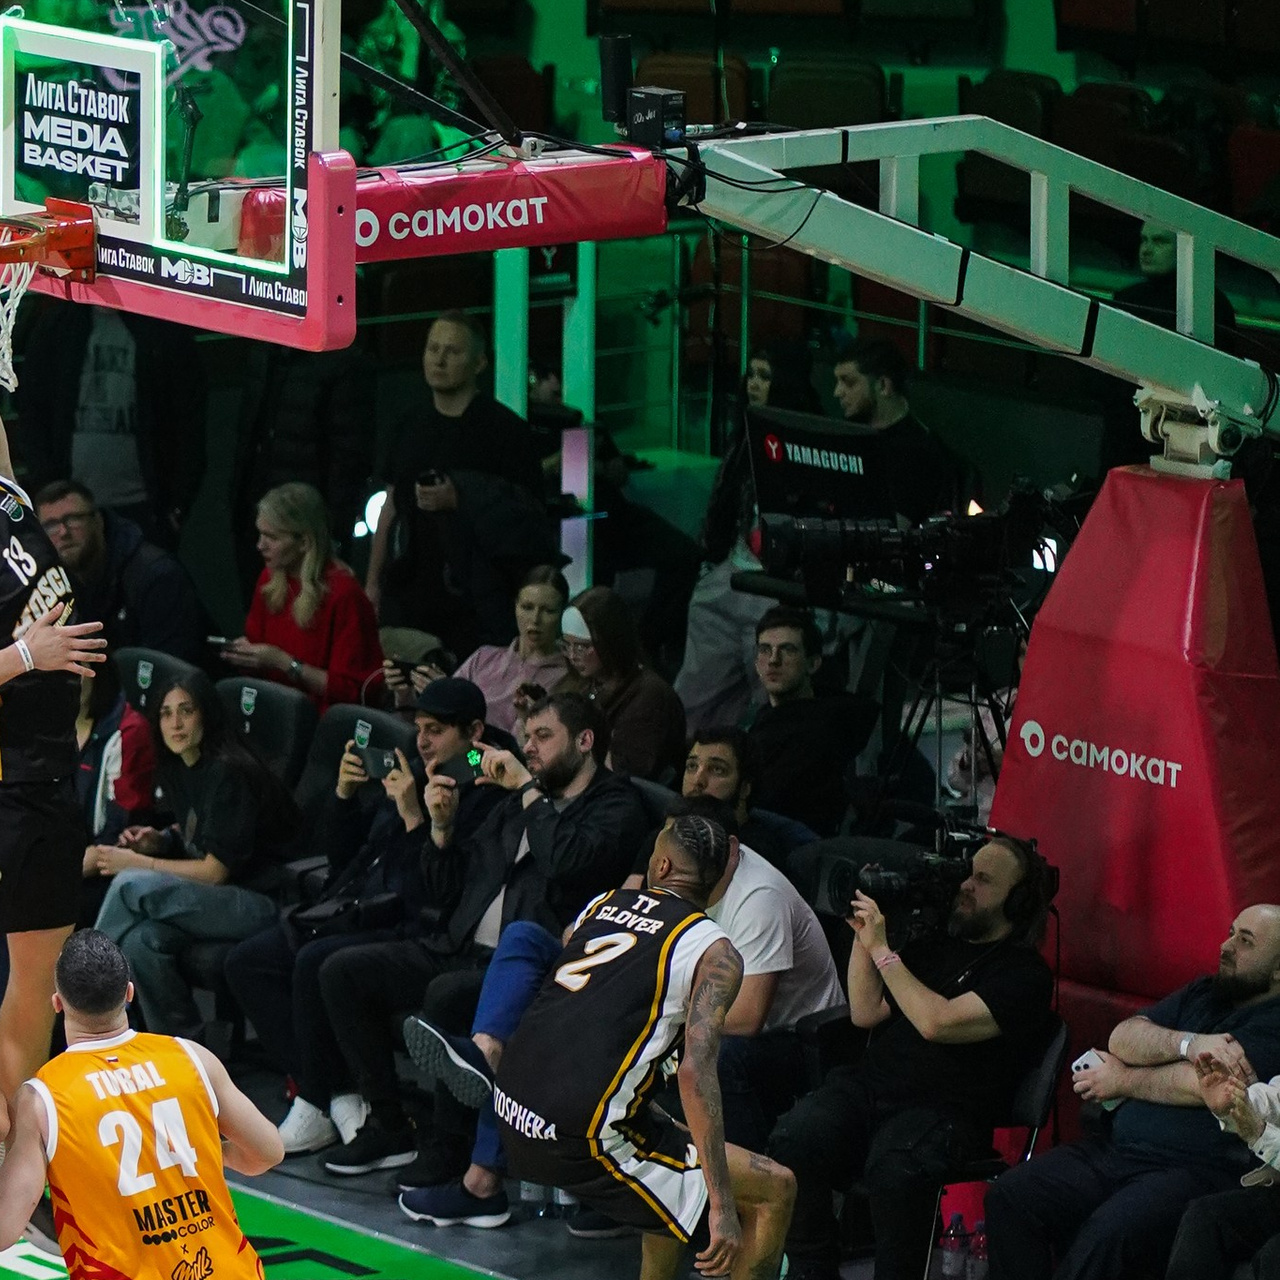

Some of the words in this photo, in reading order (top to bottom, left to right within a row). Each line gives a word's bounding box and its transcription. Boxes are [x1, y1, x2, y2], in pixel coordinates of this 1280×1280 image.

[24, 111, 128, 157] MEDIA
[24, 142, 129, 182] BASKET
[784, 441, 864, 476] YAMAGUCHI
[2, 535, 38, 587] 13
[595, 905, 664, 935] GLOVER
[631, 894, 661, 914] TY
[554, 931, 638, 993] 2
[85, 1060, 166, 1101] TUBAL
[98, 1097, 199, 1197] 24
[132, 1189, 212, 1232] MASTER
[178, 1216, 215, 1242] COLOR
